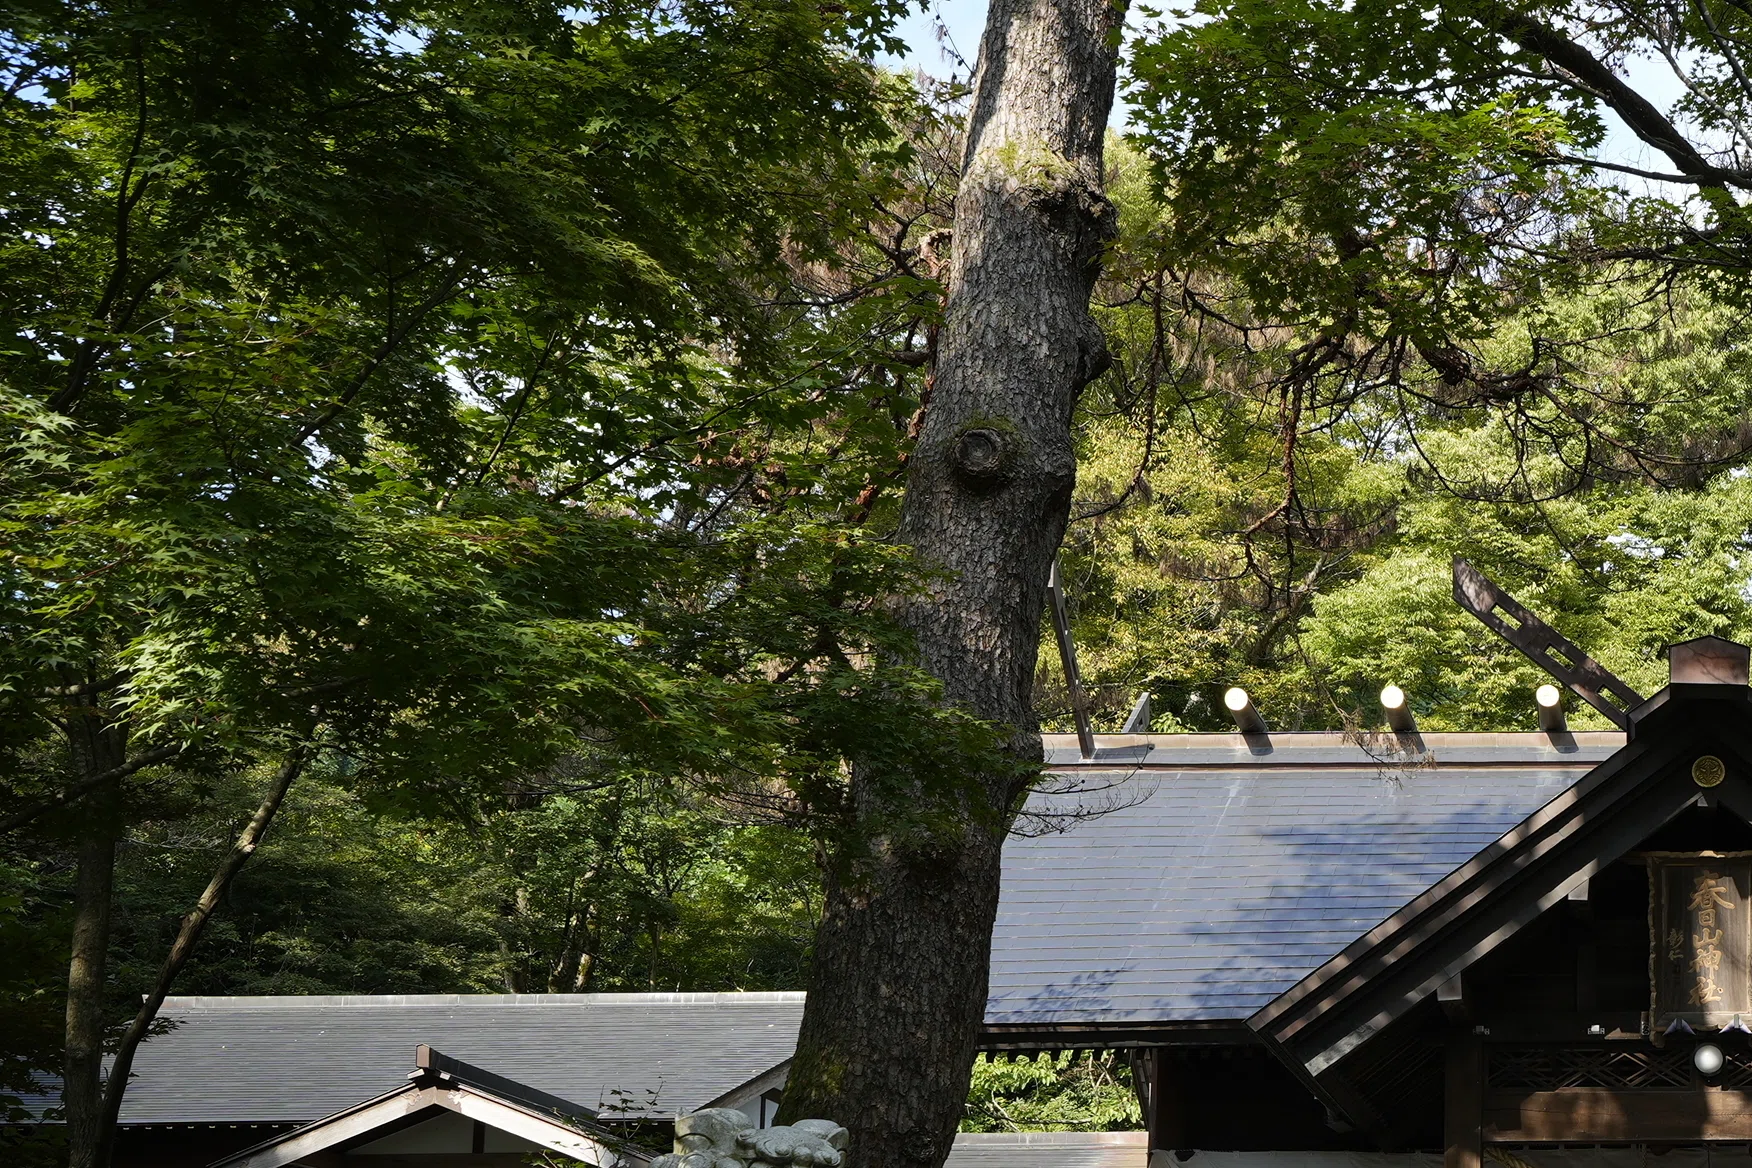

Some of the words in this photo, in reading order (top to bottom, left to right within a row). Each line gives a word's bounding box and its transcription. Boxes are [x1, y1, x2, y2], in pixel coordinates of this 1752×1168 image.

[1687, 870, 1735, 1006] 春日山神社
